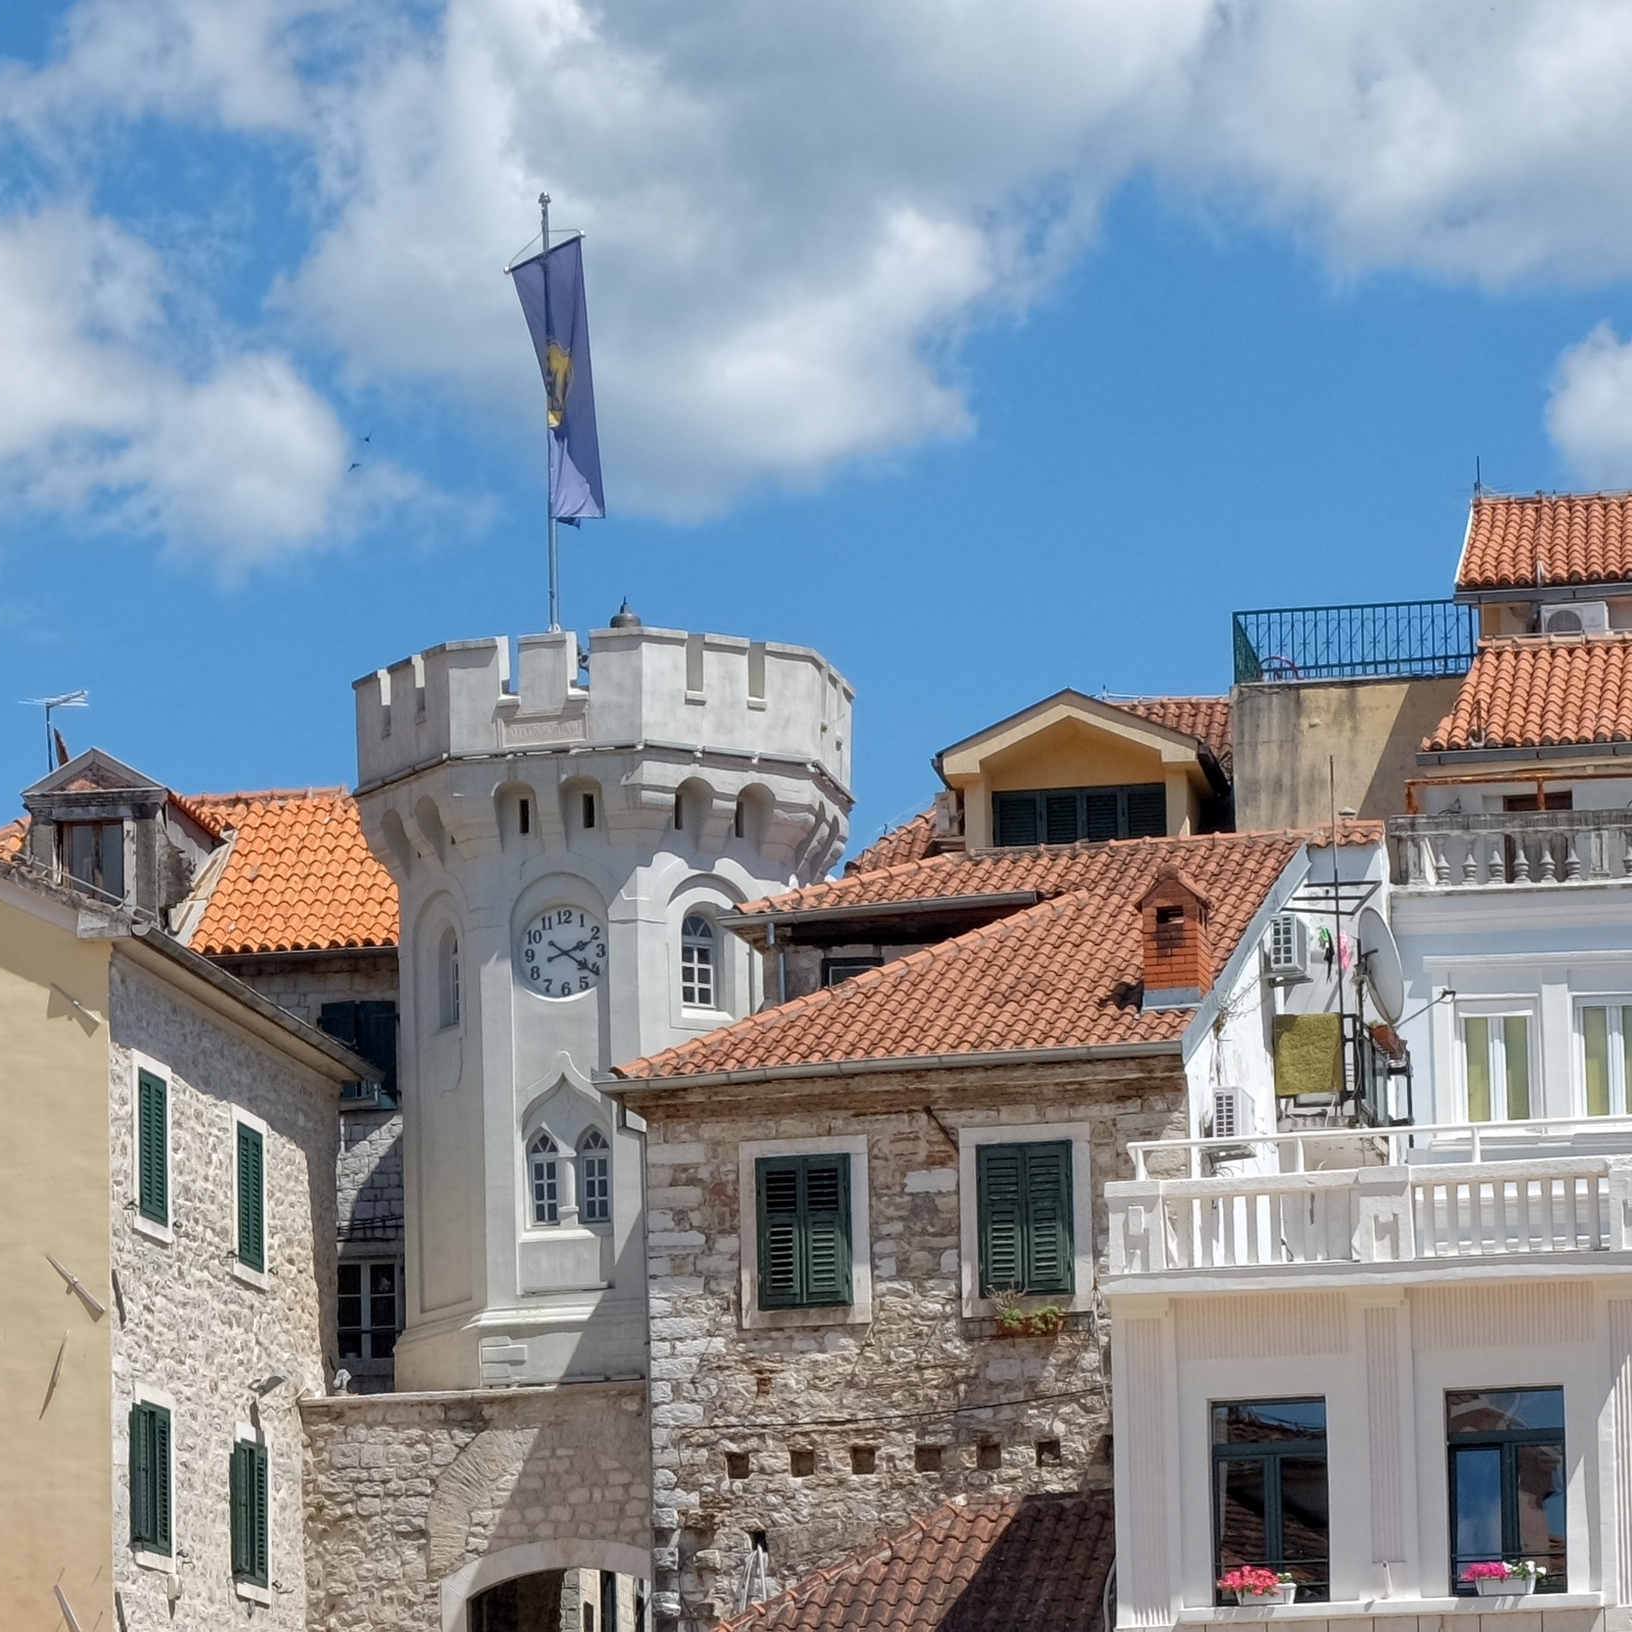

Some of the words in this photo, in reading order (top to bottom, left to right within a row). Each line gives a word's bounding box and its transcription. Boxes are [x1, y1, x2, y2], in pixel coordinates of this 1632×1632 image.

[541, 916, 553, 931] 11
[557, 909, 572, 925] 12
[579, 913, 586, 928] 1
[527, 929, 542, 945] 10
[590, 926, 600, 940] 2
[525, 949, 535, 963] 9
[596, 943, 606, 958] 3
[530, 965, 540, 981] 8
[543, 978, 553, 993] 7
[561, 981, 571, 996] 6
[579, 976, 589, 990] 5
